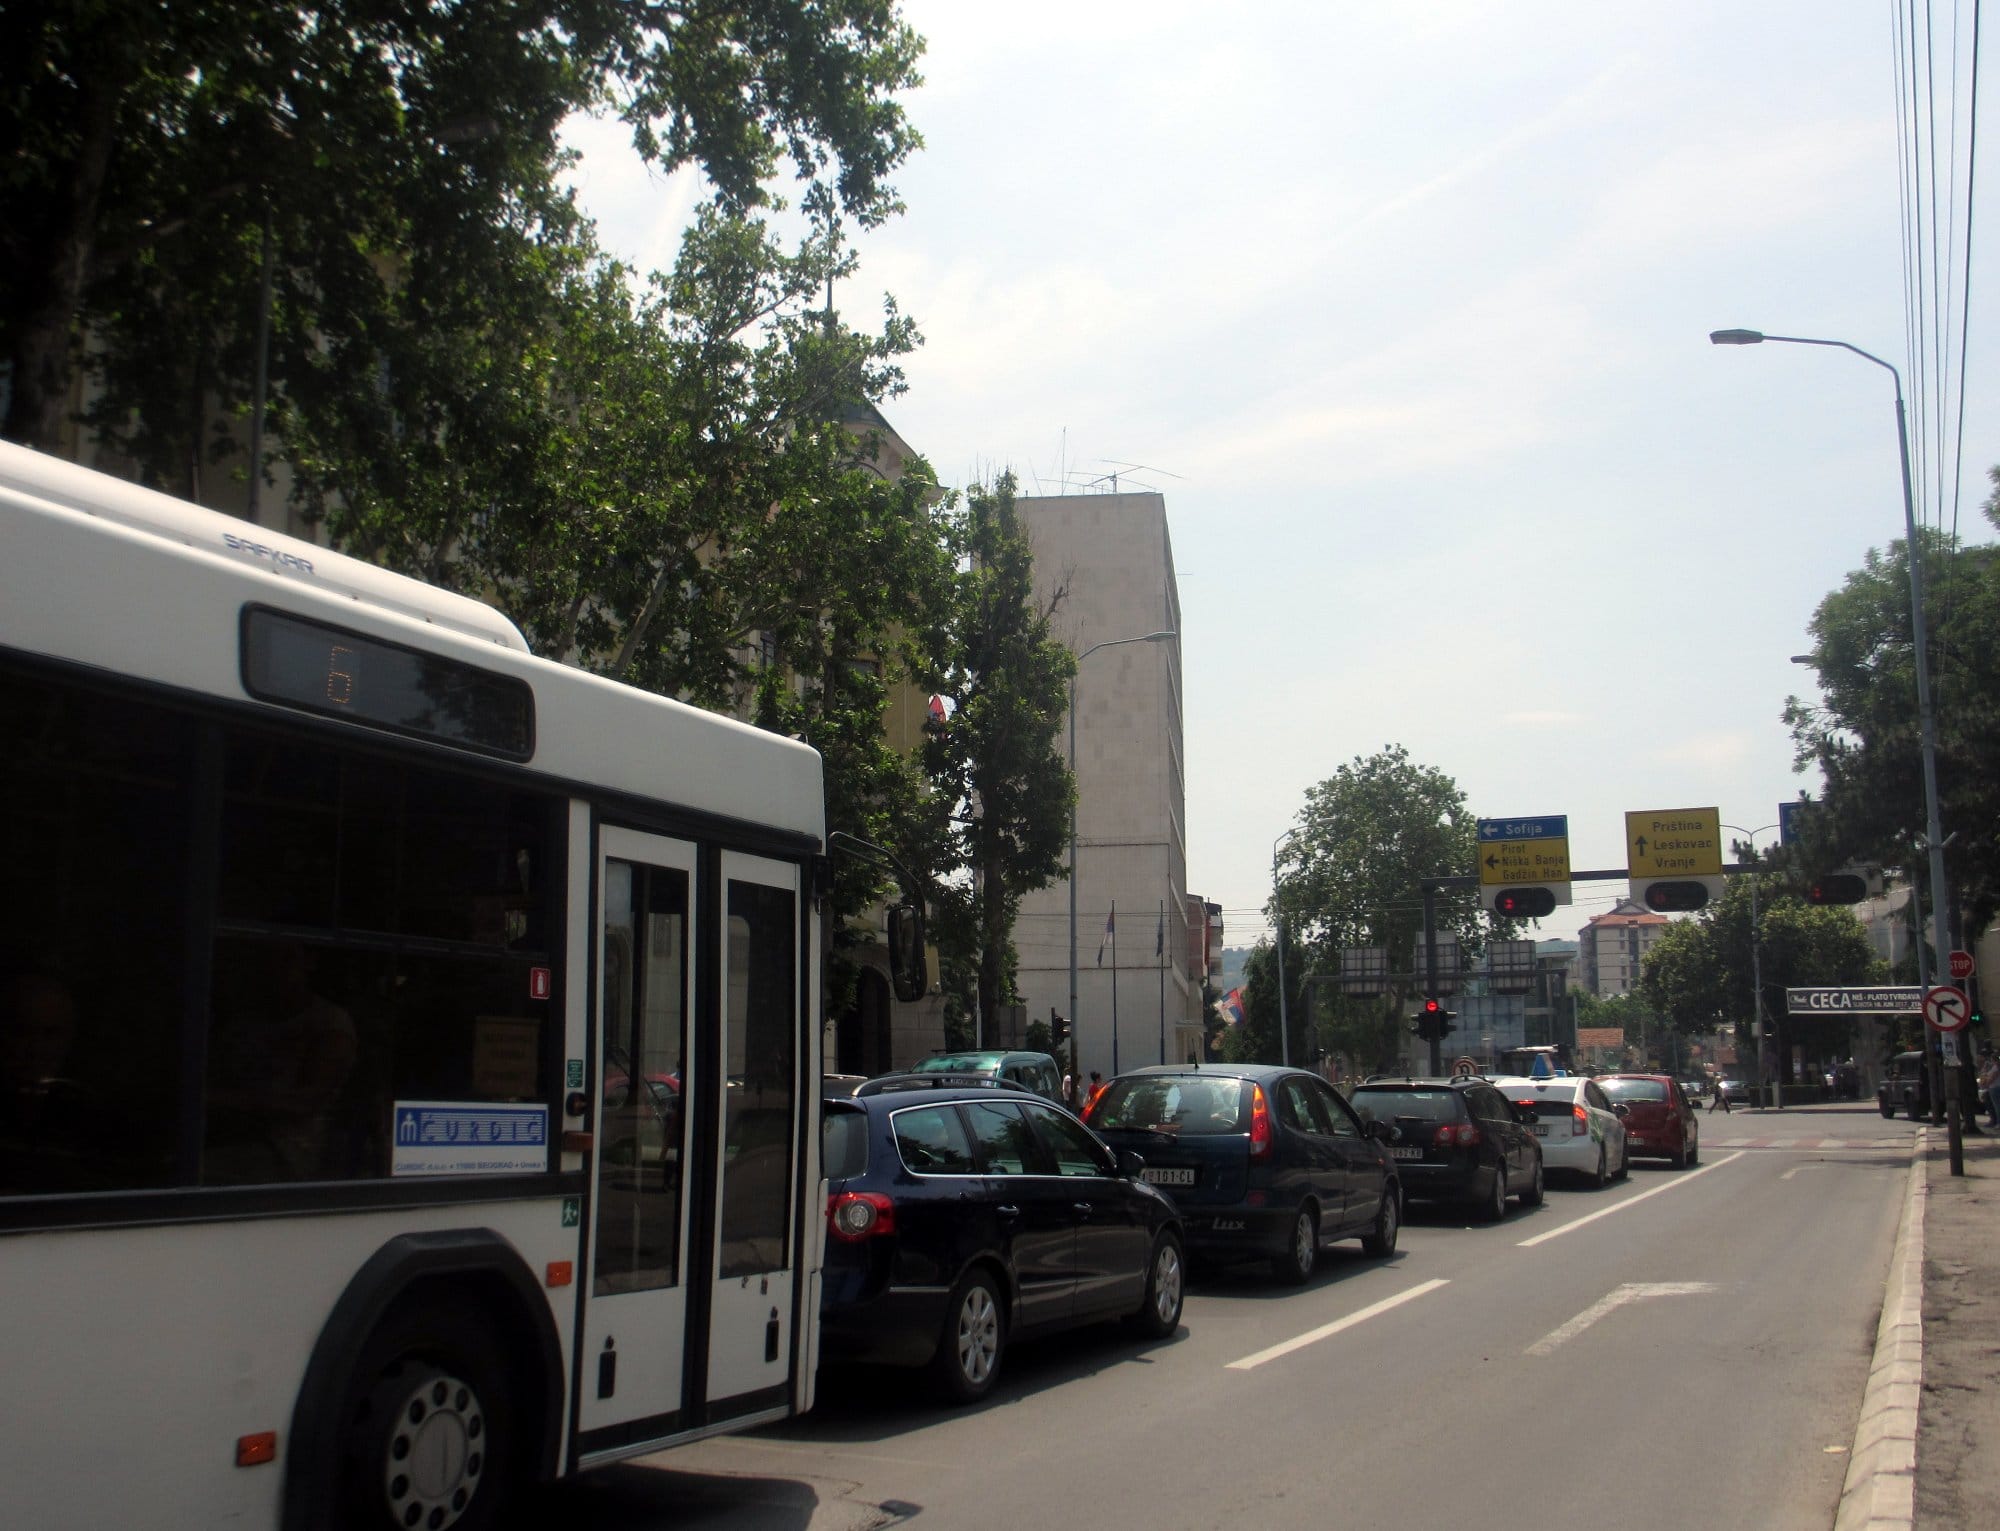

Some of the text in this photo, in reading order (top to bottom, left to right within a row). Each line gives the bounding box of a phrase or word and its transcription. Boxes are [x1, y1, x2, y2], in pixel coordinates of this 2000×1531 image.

[1505, 823, 1543, 836] Sofija
[1652, 820, 1703, 832] Priština
[1502, 844, 1526, 854] Pirot
[1653, 839, 1713, 851] Leskovac
[1535, 854, 1565, 867] Banja
[1655, 857, 1697, 870] Vranje
[1543, 868, 1563, 879] Han
[1810, 992, 1852, 1009] CECA
[1867, 993, 1889, 1001] PLATO
[477, 1160, 514, 1169] BEOGRAD
